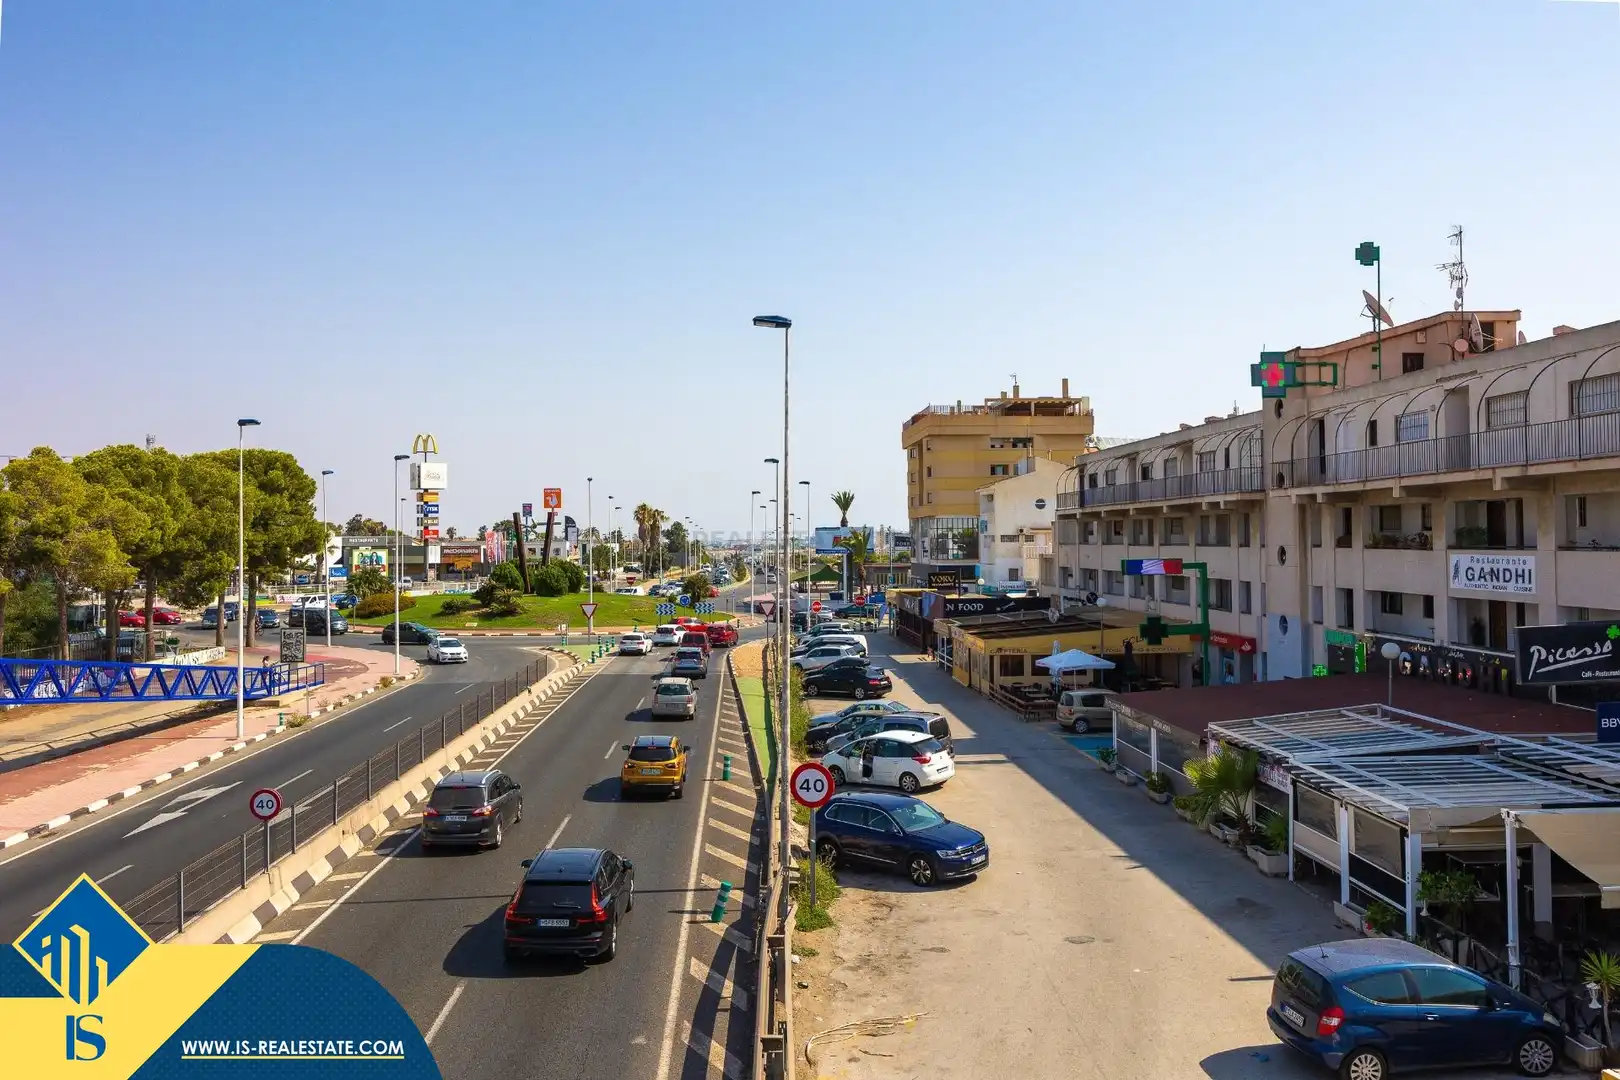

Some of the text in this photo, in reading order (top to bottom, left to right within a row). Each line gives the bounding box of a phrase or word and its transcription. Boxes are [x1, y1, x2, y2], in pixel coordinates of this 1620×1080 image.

[1470, 556, 1527, 565] Restaurante
[1465, 566, 1532, 584] GANDHI
[958, 603, 984, 611] FOOD
[1528, 640, 1612, 680] Picasso
[799, 778, 824, 793] 40
[256, 799, 274, 810] 40
